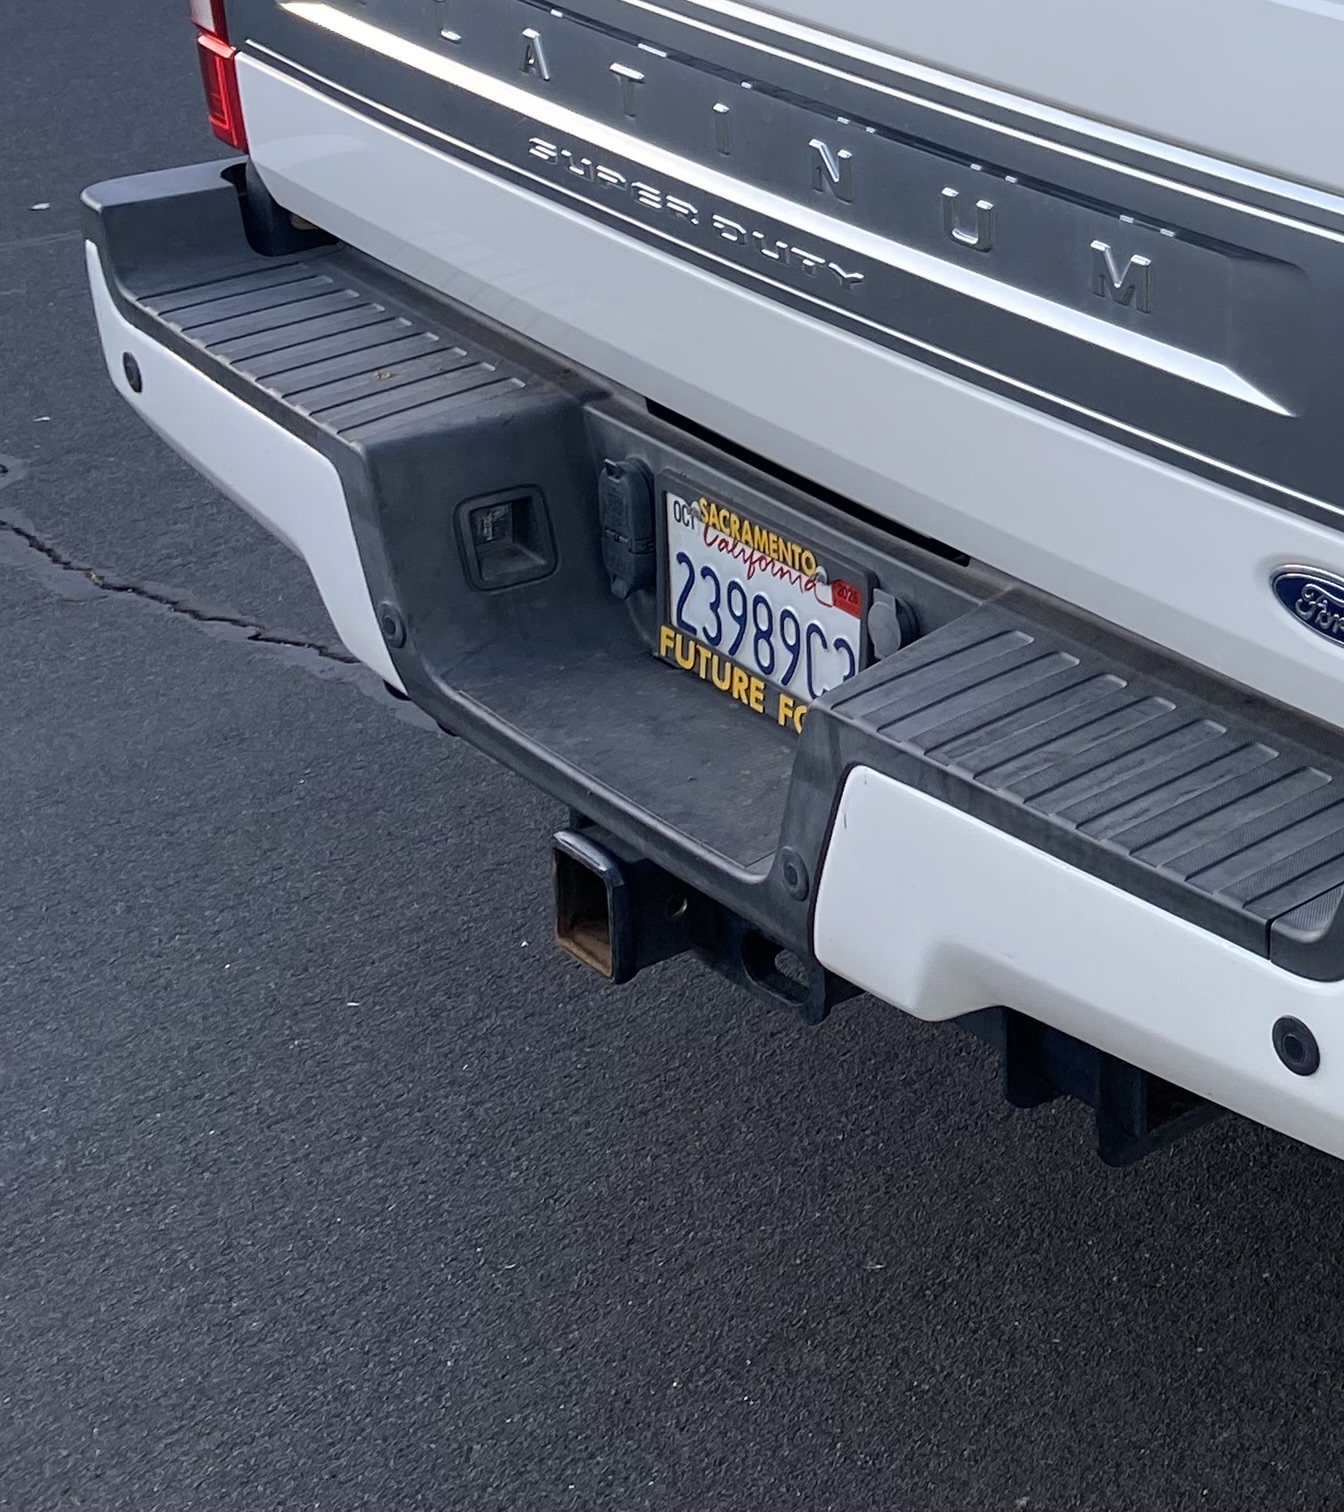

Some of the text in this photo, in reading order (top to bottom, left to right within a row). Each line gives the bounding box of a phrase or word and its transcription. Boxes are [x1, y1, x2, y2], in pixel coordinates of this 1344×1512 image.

[529, 137, 865, 289] SUPER DUTY
[699, 497, 817, 577] SACRAMENTO
[659, 625, 767, 715] FUTURE
